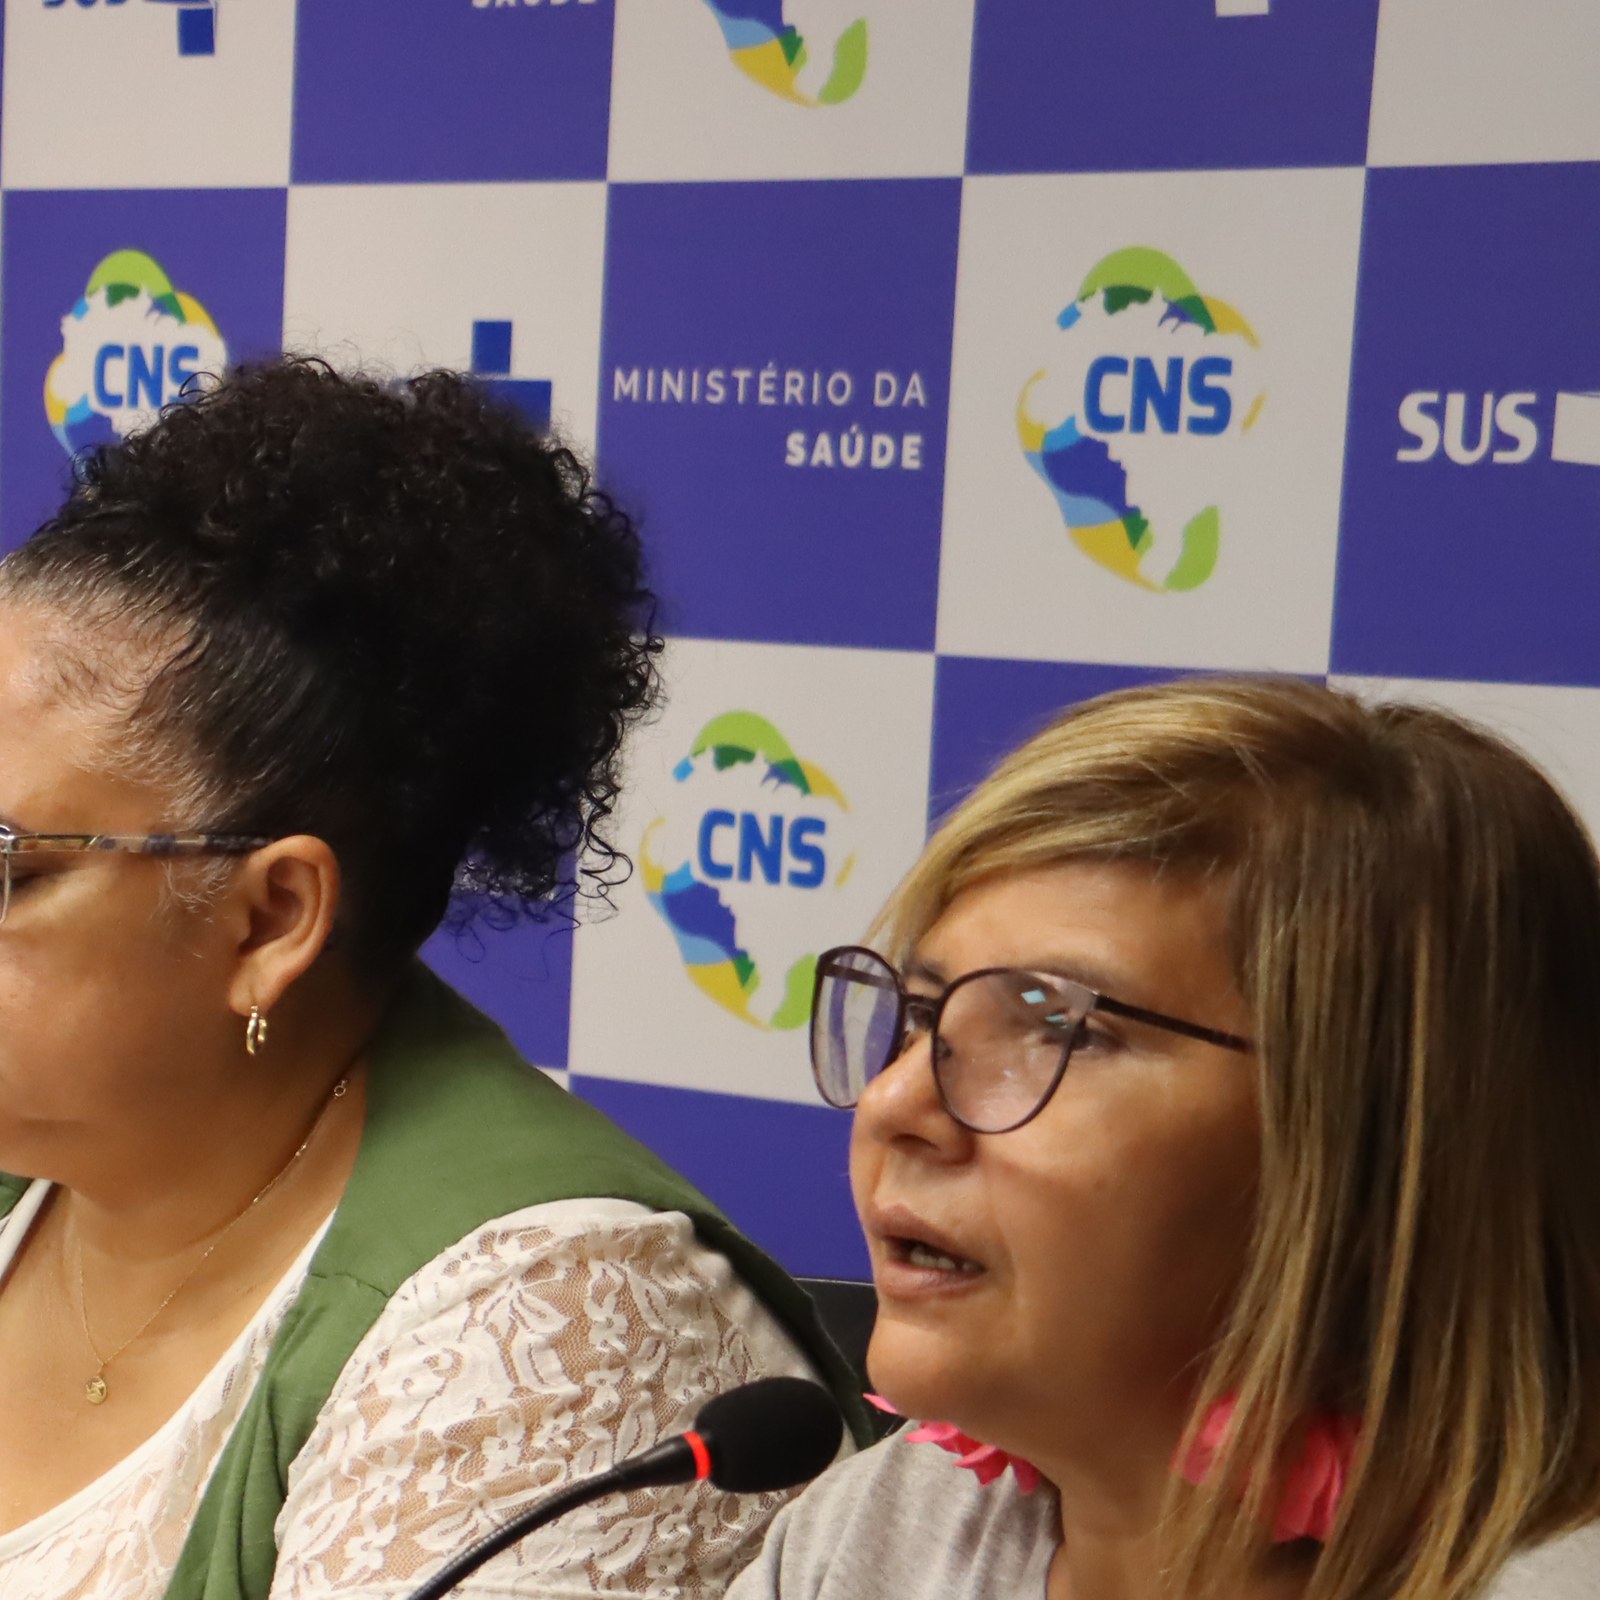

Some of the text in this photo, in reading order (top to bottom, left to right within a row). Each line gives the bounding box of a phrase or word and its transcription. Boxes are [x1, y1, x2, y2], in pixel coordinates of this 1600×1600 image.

[93, 343, 201, 409] CNS
[612, 361, 927, 408] MINISTÉRIO DA
[1083, 355, 1233, 435] CNS
[785, 425, 923, 469] SAÚDE
[1396, 390, 1538, 465] SUS
[698, 808, 826, 889] CNS
